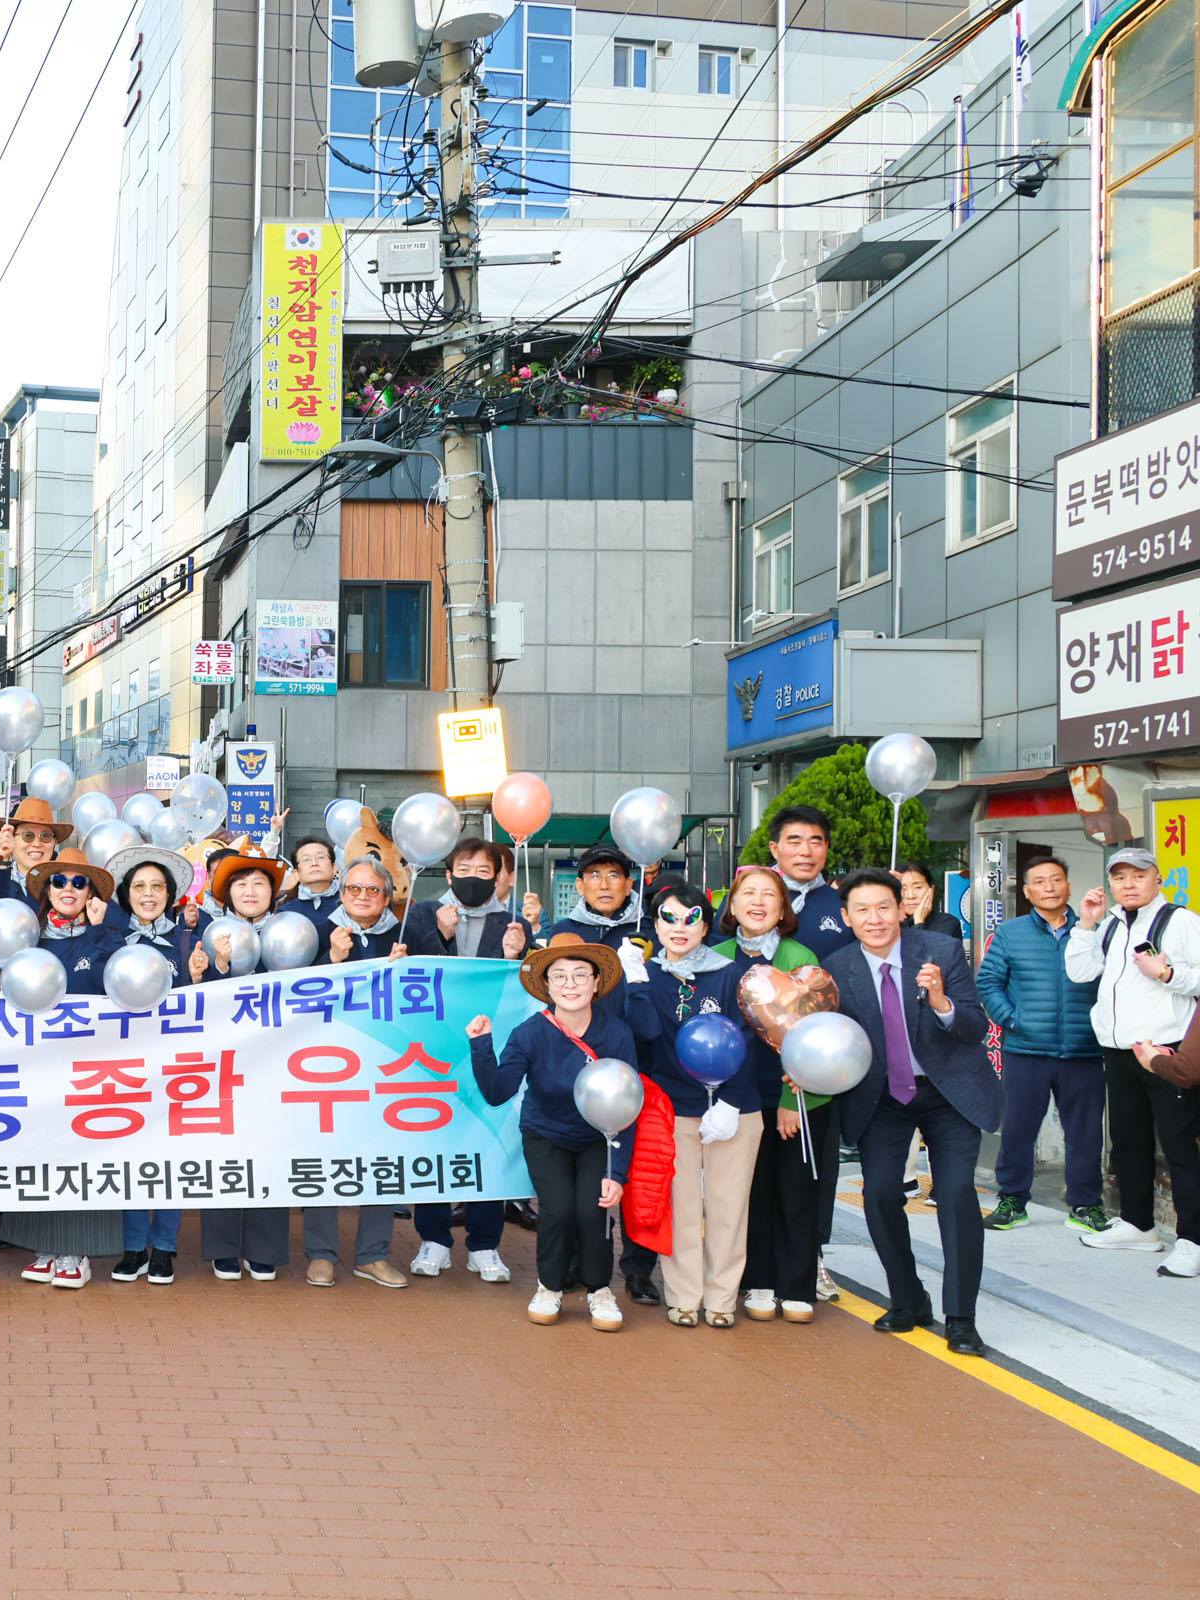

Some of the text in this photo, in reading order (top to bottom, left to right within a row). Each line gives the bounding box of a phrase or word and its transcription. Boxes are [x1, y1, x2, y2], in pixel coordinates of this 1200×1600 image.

[277, 447, 331, 457] 010-7511-489
[1091, 524, 1193, 578] 574-9514
[194, 642, 234, 658] 쑥뜸
[1066, 609, 1200, 694] 양재닭
[194, 660, 234, 675] 좌훈
[288, 682, 325, 694] 571-9994
[775, 683, 820, 710] 경찰 POLICE
[1093, 709, 1191, 749] 572-1741
[148, 771, 178, 781] RAON
[230, 966, 446, 1028] 체육대회
[64, 1048, 245, 1140] 종합
[280, 1041, 460, 1134] 우승
[286, 1152, 485, 1199] 통장협의회
